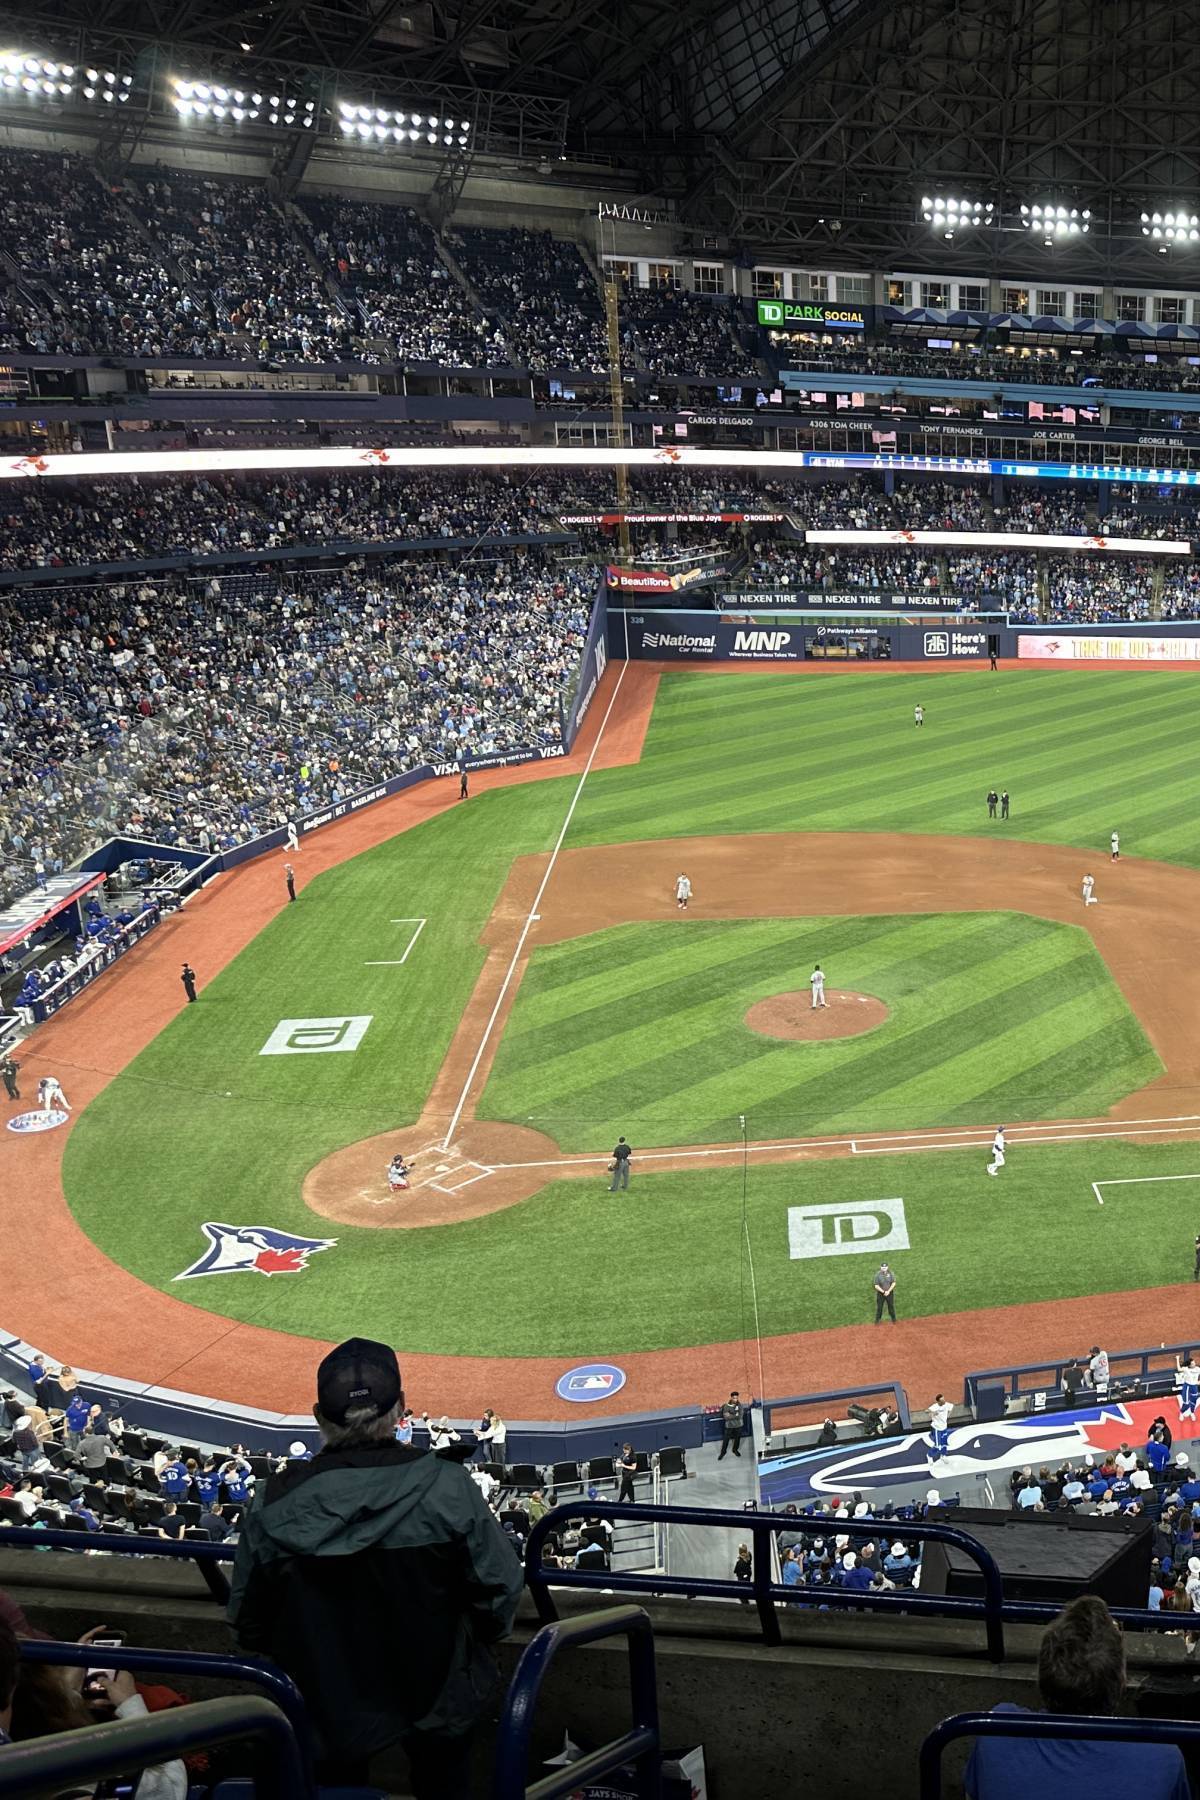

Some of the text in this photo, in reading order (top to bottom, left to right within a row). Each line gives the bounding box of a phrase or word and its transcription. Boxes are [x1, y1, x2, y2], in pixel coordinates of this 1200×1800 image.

[760, 305, 864, 322] TD PARK SOCIAL
[849, 422, 873, 430] CHEEK
[920, 425, 983, 435] TONY FERNANDEZ
[1033, 431, 1075, 440] JOE CARTER
[1138, 437, 1184, 446] GEORGE BELL
[624, 515, 645, 523] Proud
[705, 515, 721, 523] Jays
[620, 576, 670, 587] BeautiTone
[740, 594, 797, 603] NEXEN TIRE
[825, 595, 881, 604] NEXEN TIRE
[908, 596, 963, 606] NEXEN TIRE
[734, 631, 792, 651] MNP
[951, 632, 986, 644] Here's
[951, 643, 980, 655] How.
[431, 761, 461, 777] VISA
[464, 758, 496, 769] everywhere
[506, 754, 520, 763] want
[537, 745, 565, 759] VISA
[335, 804, 347, 817] BET
[803, 1210, 893, 1245] TD
[588, 1789, 610, 1799] JAYS
